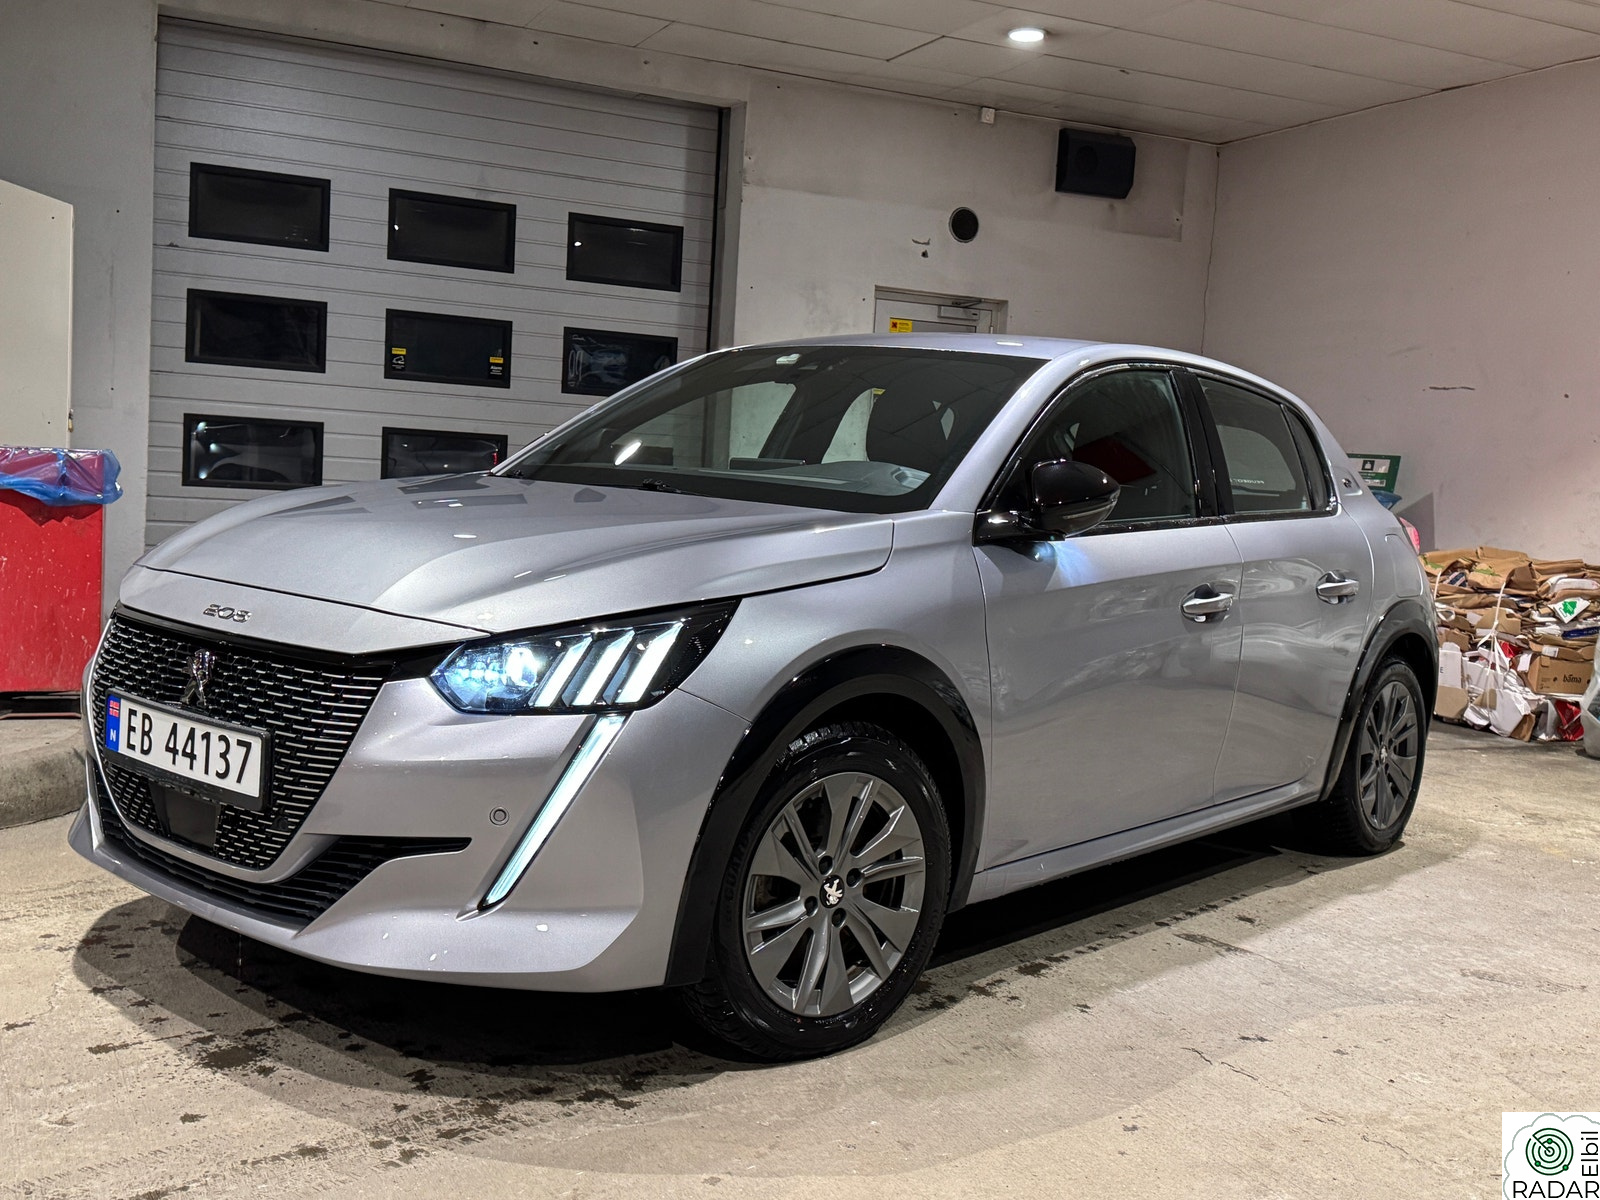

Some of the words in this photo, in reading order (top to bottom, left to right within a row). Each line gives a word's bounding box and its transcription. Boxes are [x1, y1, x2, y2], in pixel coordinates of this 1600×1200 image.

[203, 603, 252, 623] 208
[109, 728, 117, 742] N
[126, 708, 153, 756] EB
[165, 722, 252, 784] 44137
